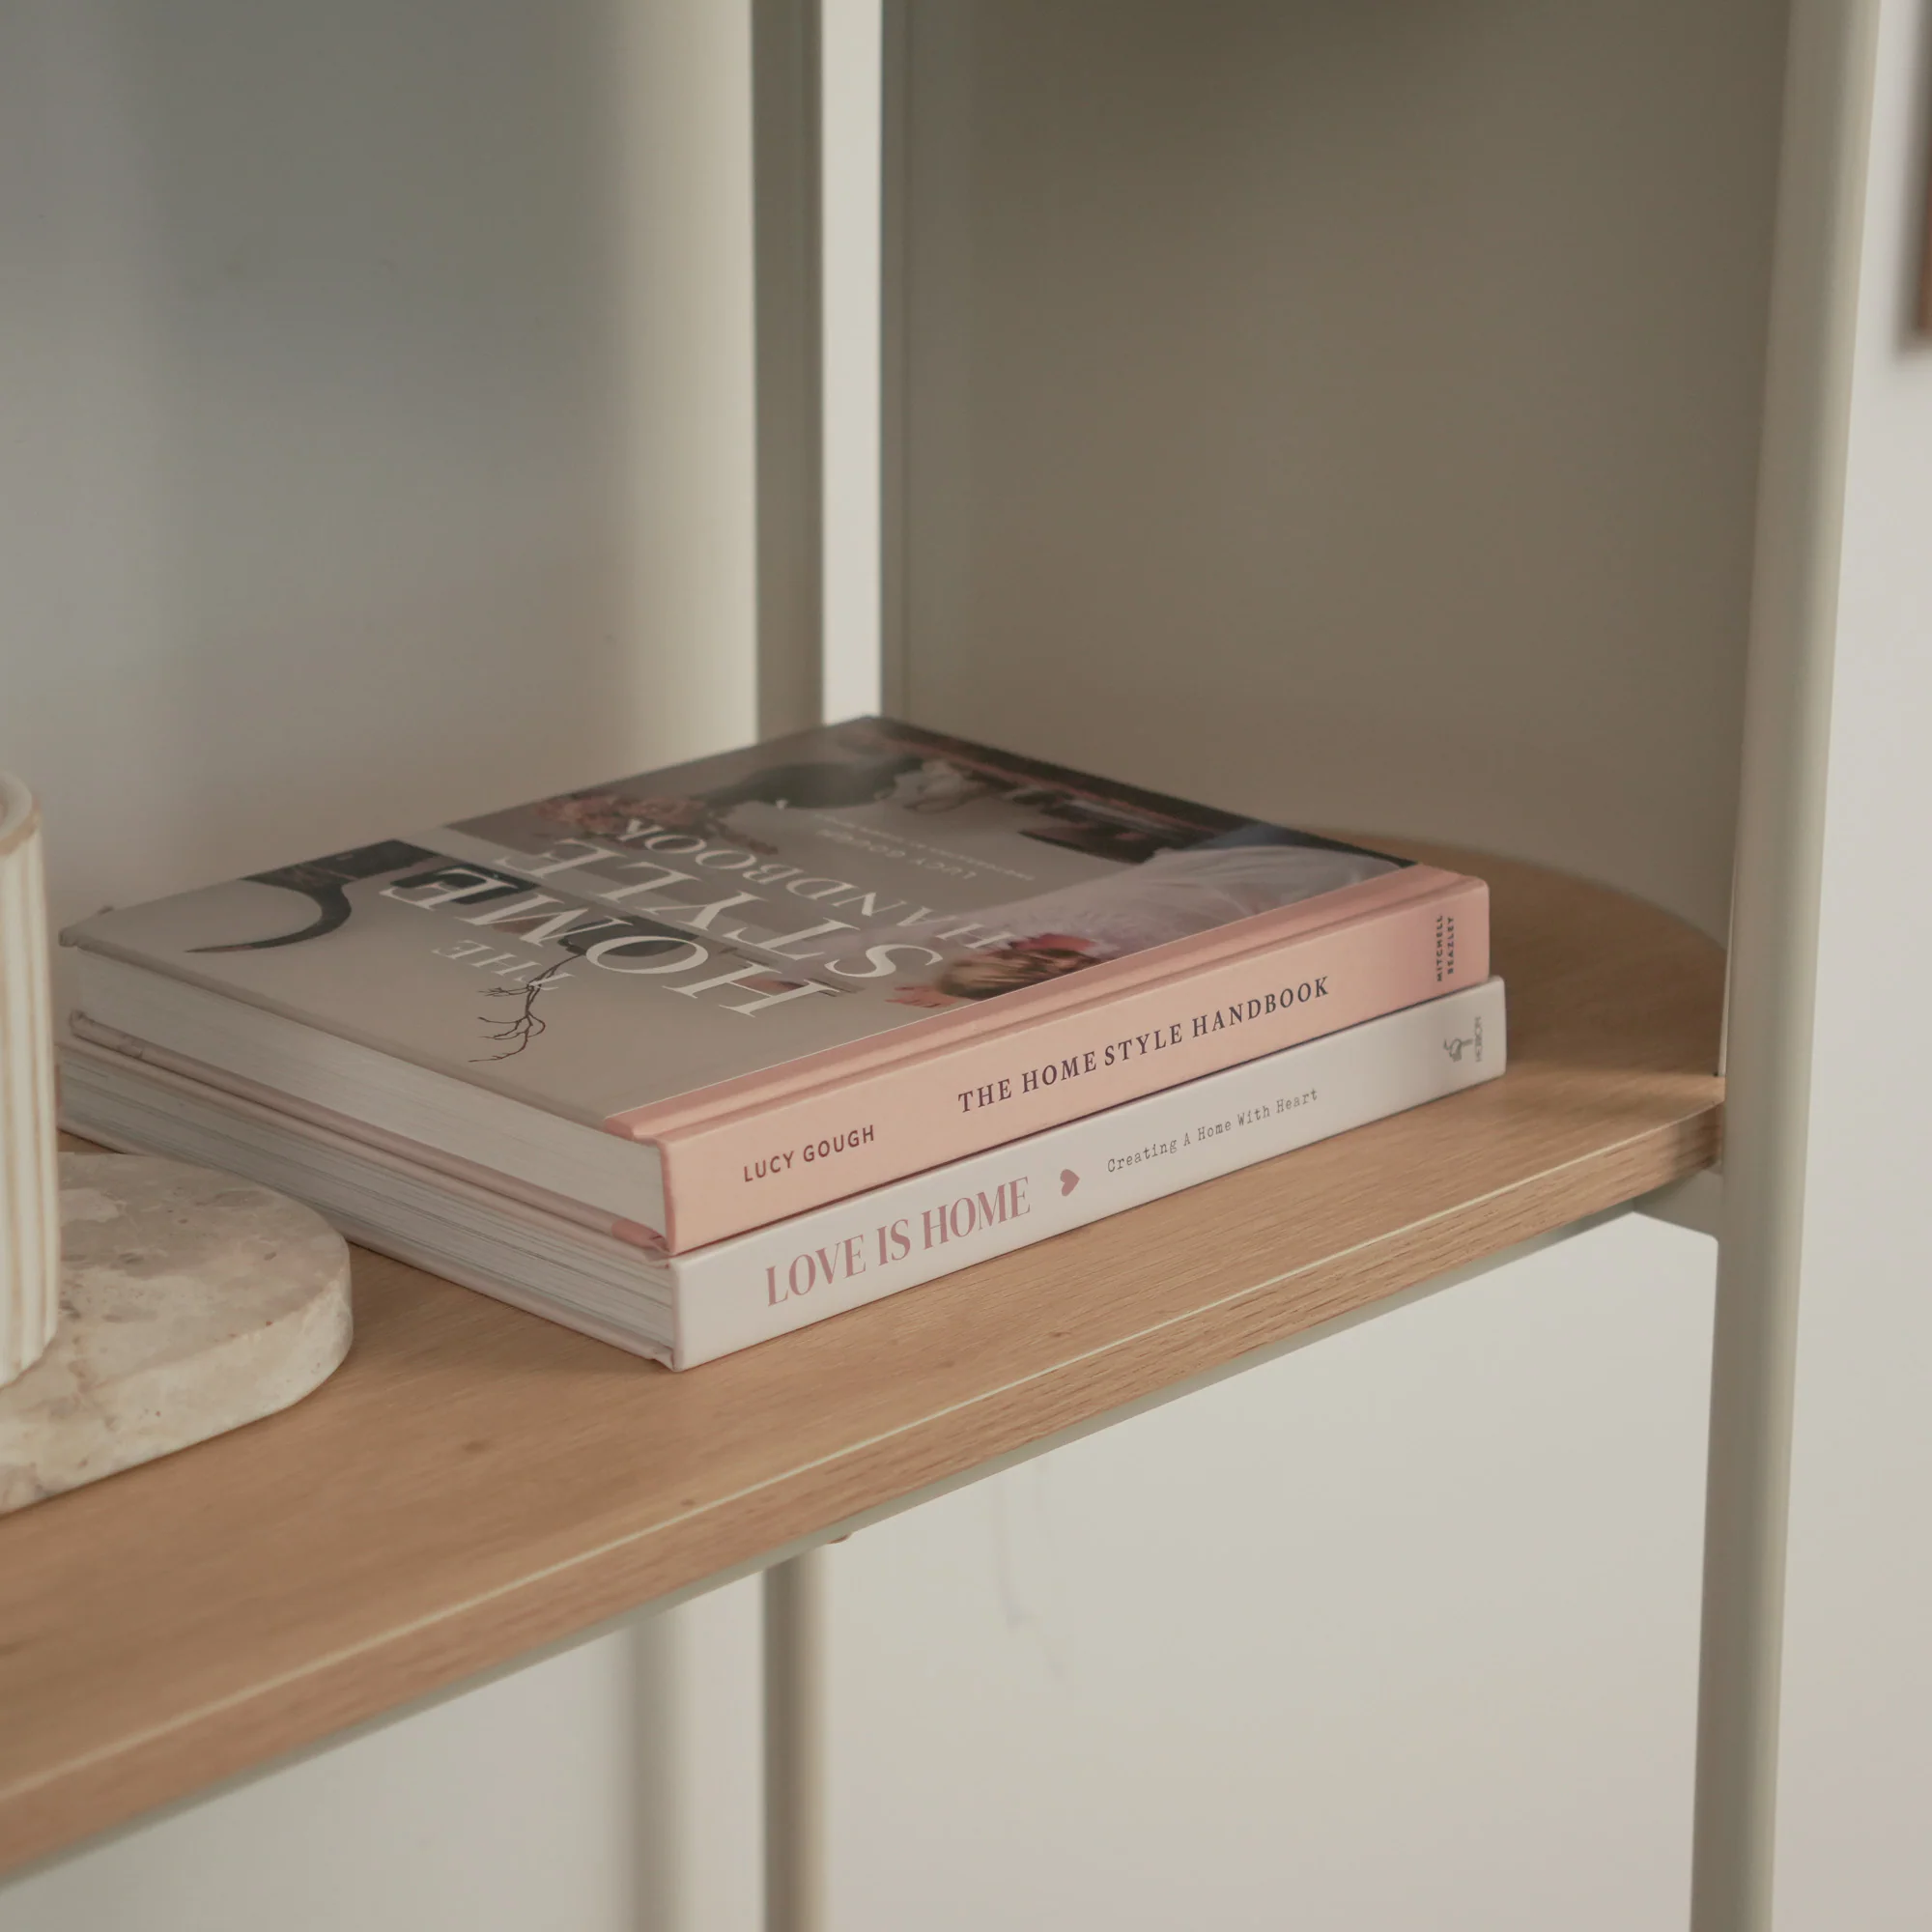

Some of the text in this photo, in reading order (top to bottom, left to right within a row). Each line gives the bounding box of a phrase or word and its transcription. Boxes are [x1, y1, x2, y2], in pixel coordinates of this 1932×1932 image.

[379, 867, 840, 1017] HOME
[493, 837, 944, 978] STYLE
[616, 818, 1015, 951] HANDBOOK
[1435, 915, 1444, 982] MITCHELL
[431, 940, 576, 991] THE
[957, 976, 1330, 1113] THE HOME STYLE HANDBOOK
[743, 1123, 875, 1182] LUCY GOUGH
[1107, 1088, 1319, 1173] Creating A Home With Heart
[765, 1176, 1031, 1307] LOVE IS HOME
